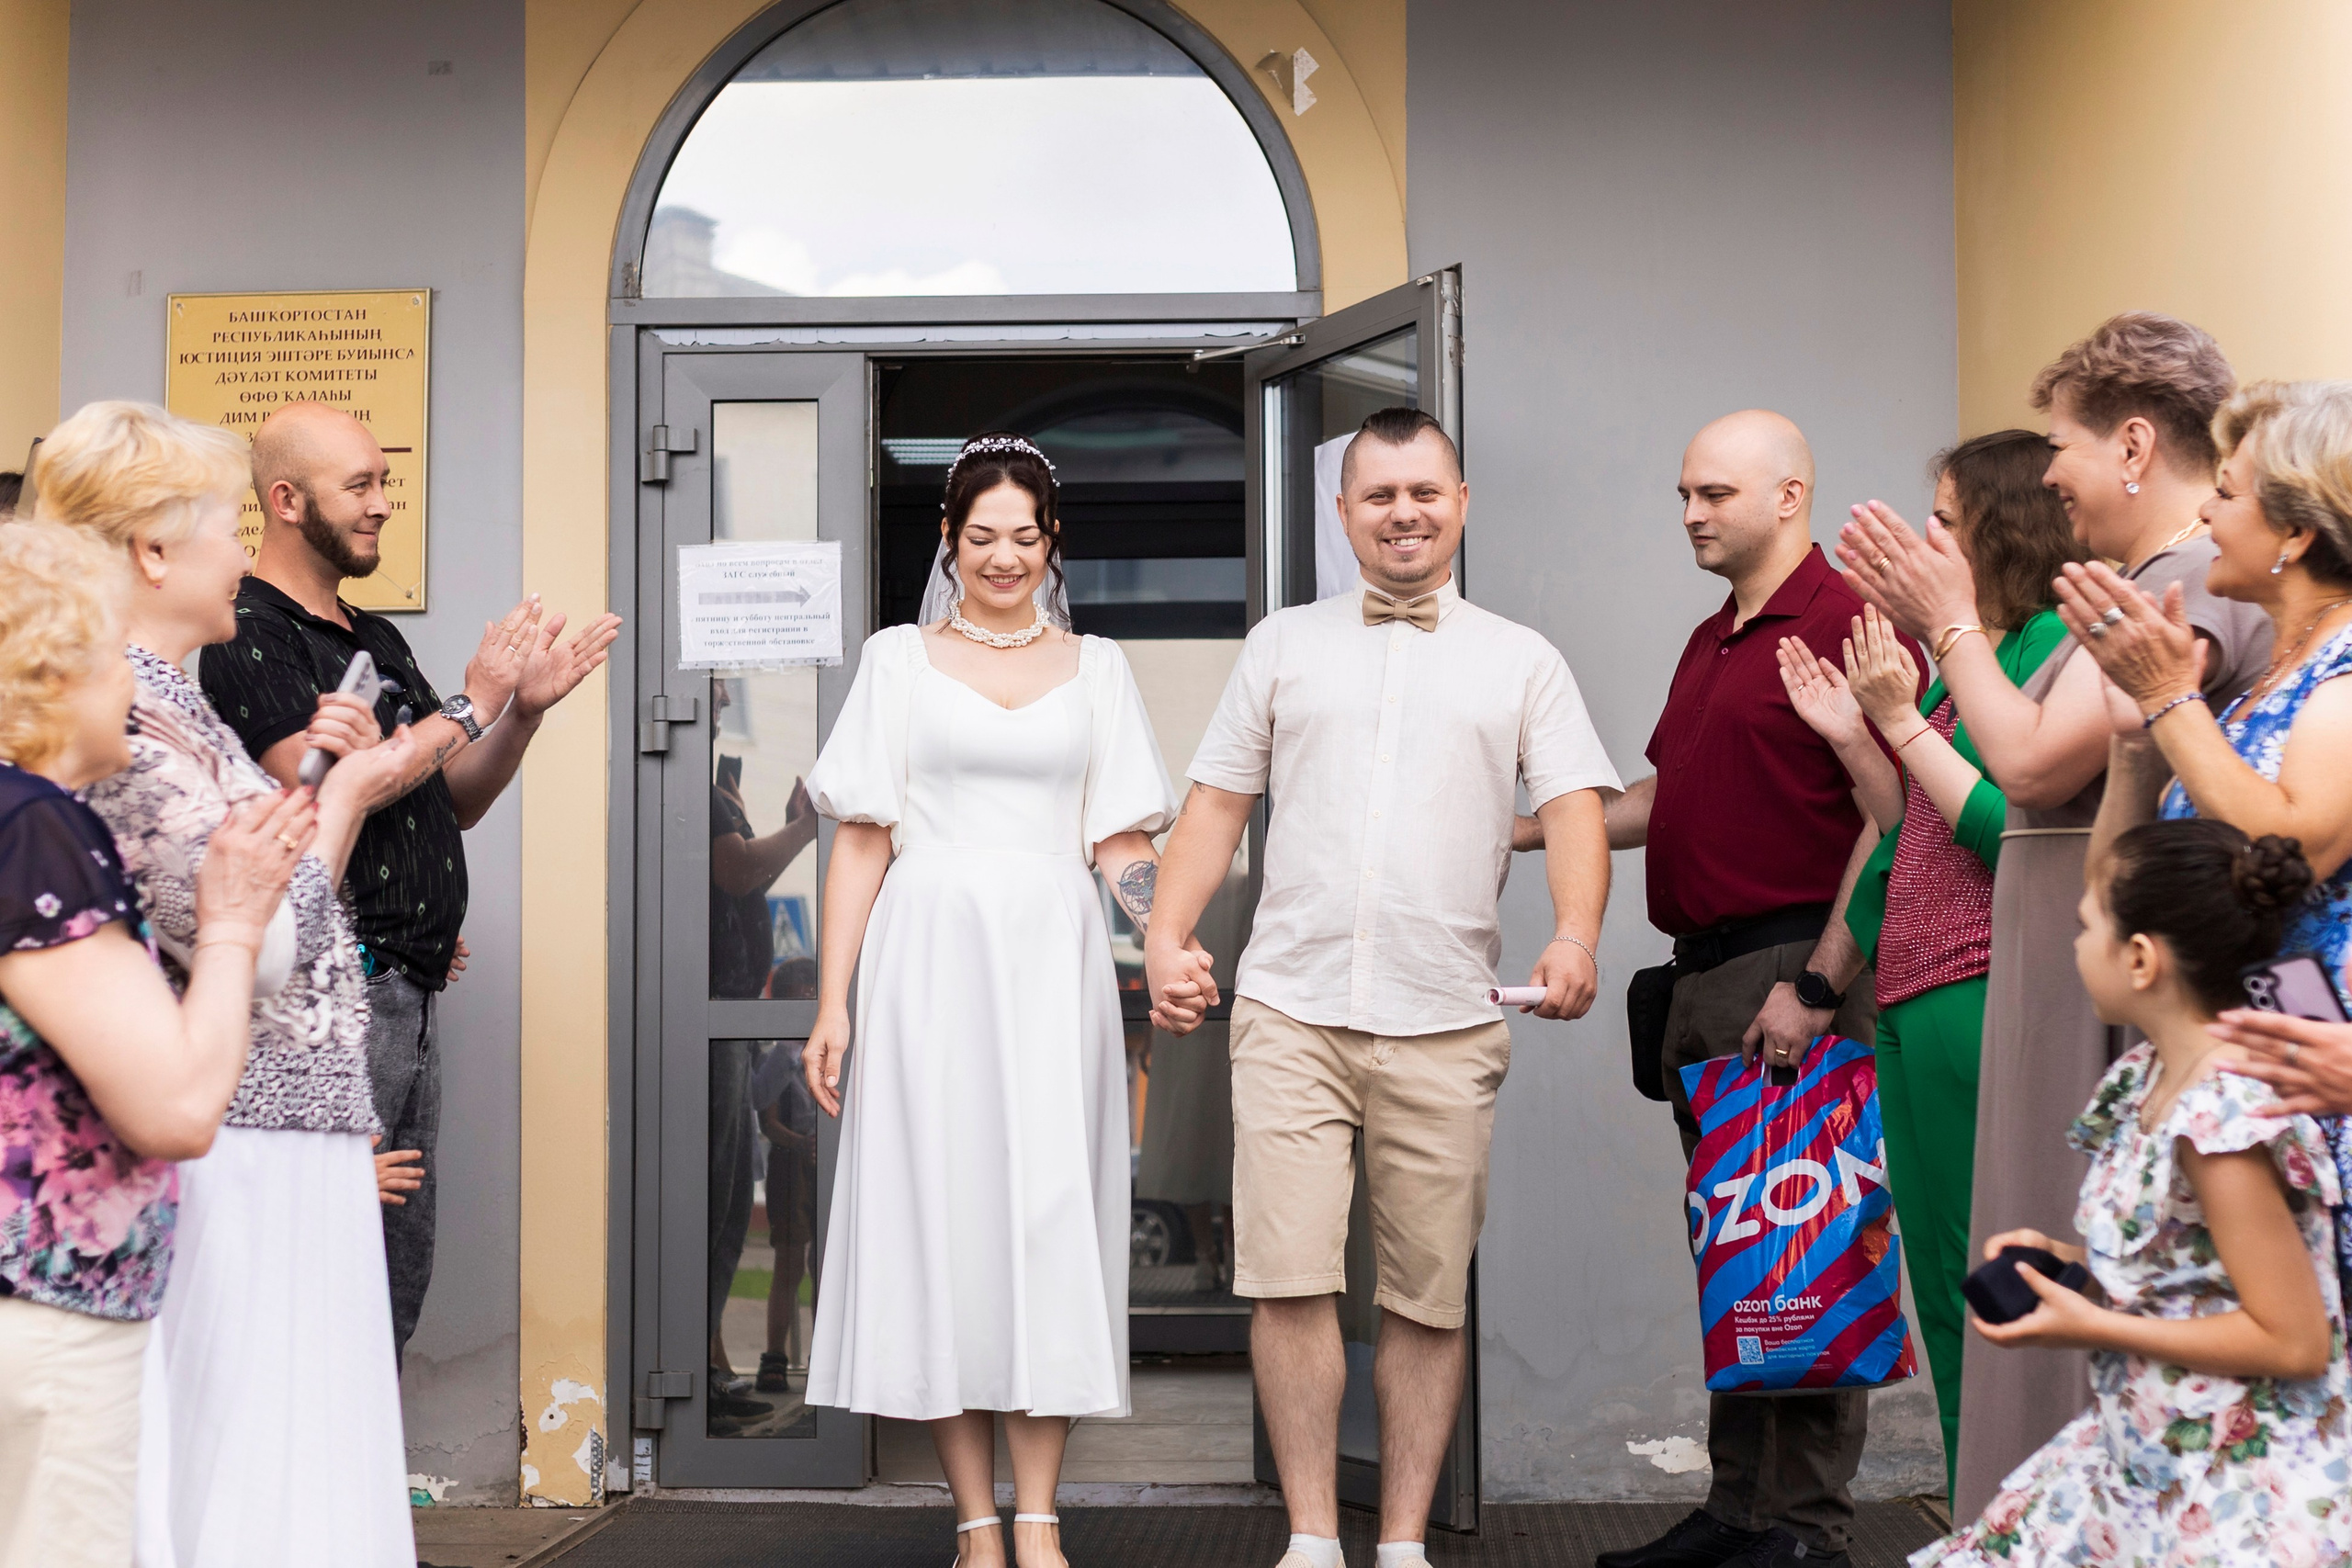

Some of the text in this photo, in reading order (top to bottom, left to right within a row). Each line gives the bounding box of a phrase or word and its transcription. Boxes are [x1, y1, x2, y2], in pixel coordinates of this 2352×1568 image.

[230, 310, 367, 322] БАШҠОРТОСТАН
[179, 345, 415, 365] ЮСТИЦИЯ ЭШТӘРЕ БУЙЫНСА
[214, 368, 378, 385] ДӘҮЛӘТ КОМИТЕТЫ
[239, 390, 277, 403] ӨФӨ
[220, 412, 257, 425] ДИМ
[1733, 1293, 1823, 1313] ozon банк
[1735, 1315, 1758, 1324] Кешбэк
[1769, 1314, 1782, 1323] 25%
[1783, 1314, 1815, 1324] рублями
